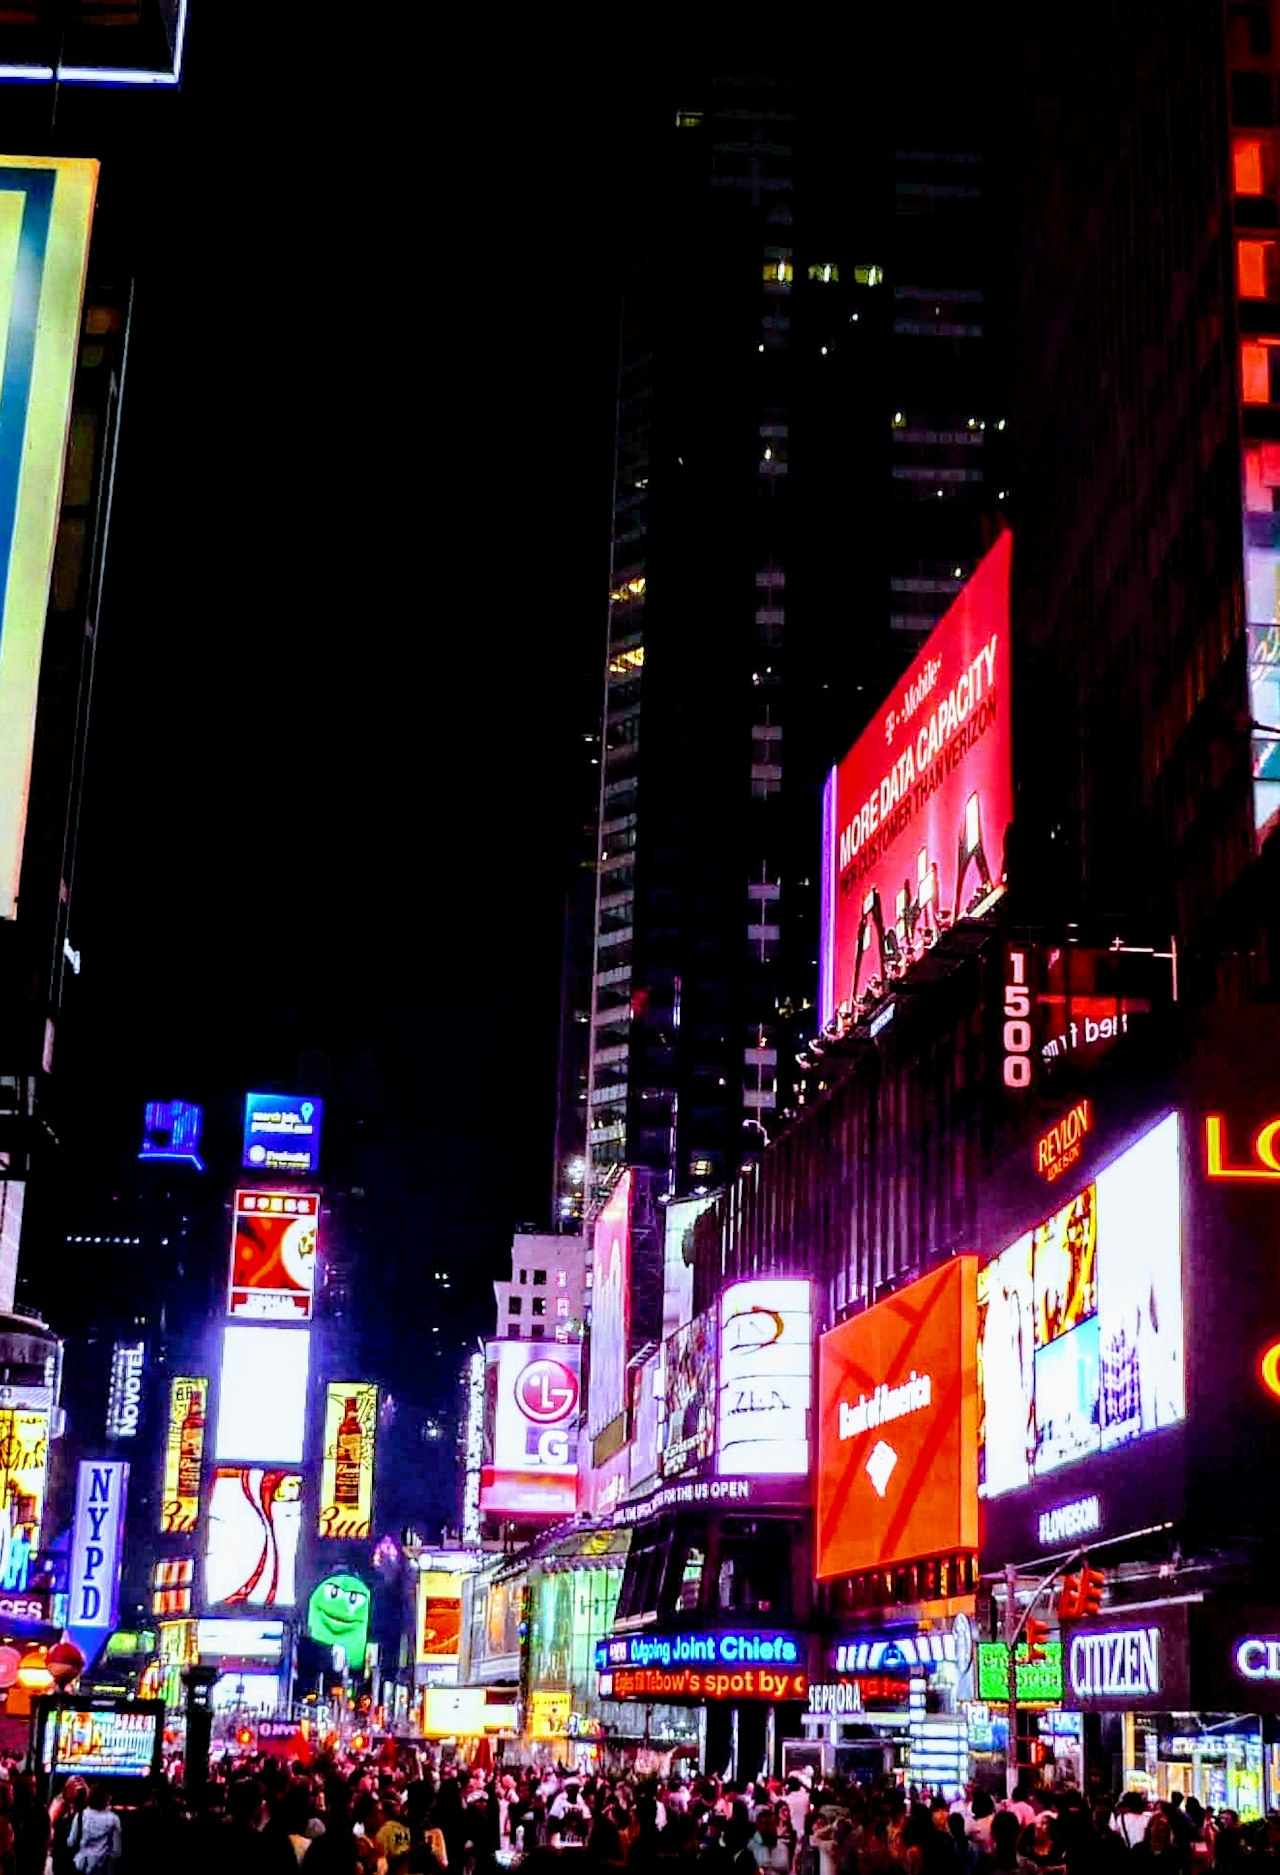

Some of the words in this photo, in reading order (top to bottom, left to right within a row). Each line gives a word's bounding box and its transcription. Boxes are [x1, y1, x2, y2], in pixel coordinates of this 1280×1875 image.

[840, 788, 880, 874] MORE
[880, 745, 916, 822] DATA
[916, 633, 997, 774] CAPACITY
[859, 803, 912, 881] CUSTOMER
[915, 765, 943, 813] THAN
[943, 692, 997, 780] VERIZON
[1003, 952, 1031, 1087] 1500
[1038, 1099, 1087, 1171] REVLON
[119, 1341, 145, 1437] NOVOTEL
[524, 1430, 569, 1464] LG
[694, 1483, 709, 1499] US
[710, 1480, 749, 1498] OPEN
[80, 1468, 113, 1619] NYPD
[673, 1635, 716, 1660] Joint
[720, 1634, 798, 1662] Chiefs
[1071, 1628, 1160, 1695] CITIZEN
[645, 1670, 700, 1692] Tebow's
[704, 1671, 754, 1695] spot
[758, 1670, 789, 1697] by
[808, 1683, 861, 1714] SEPHORA
